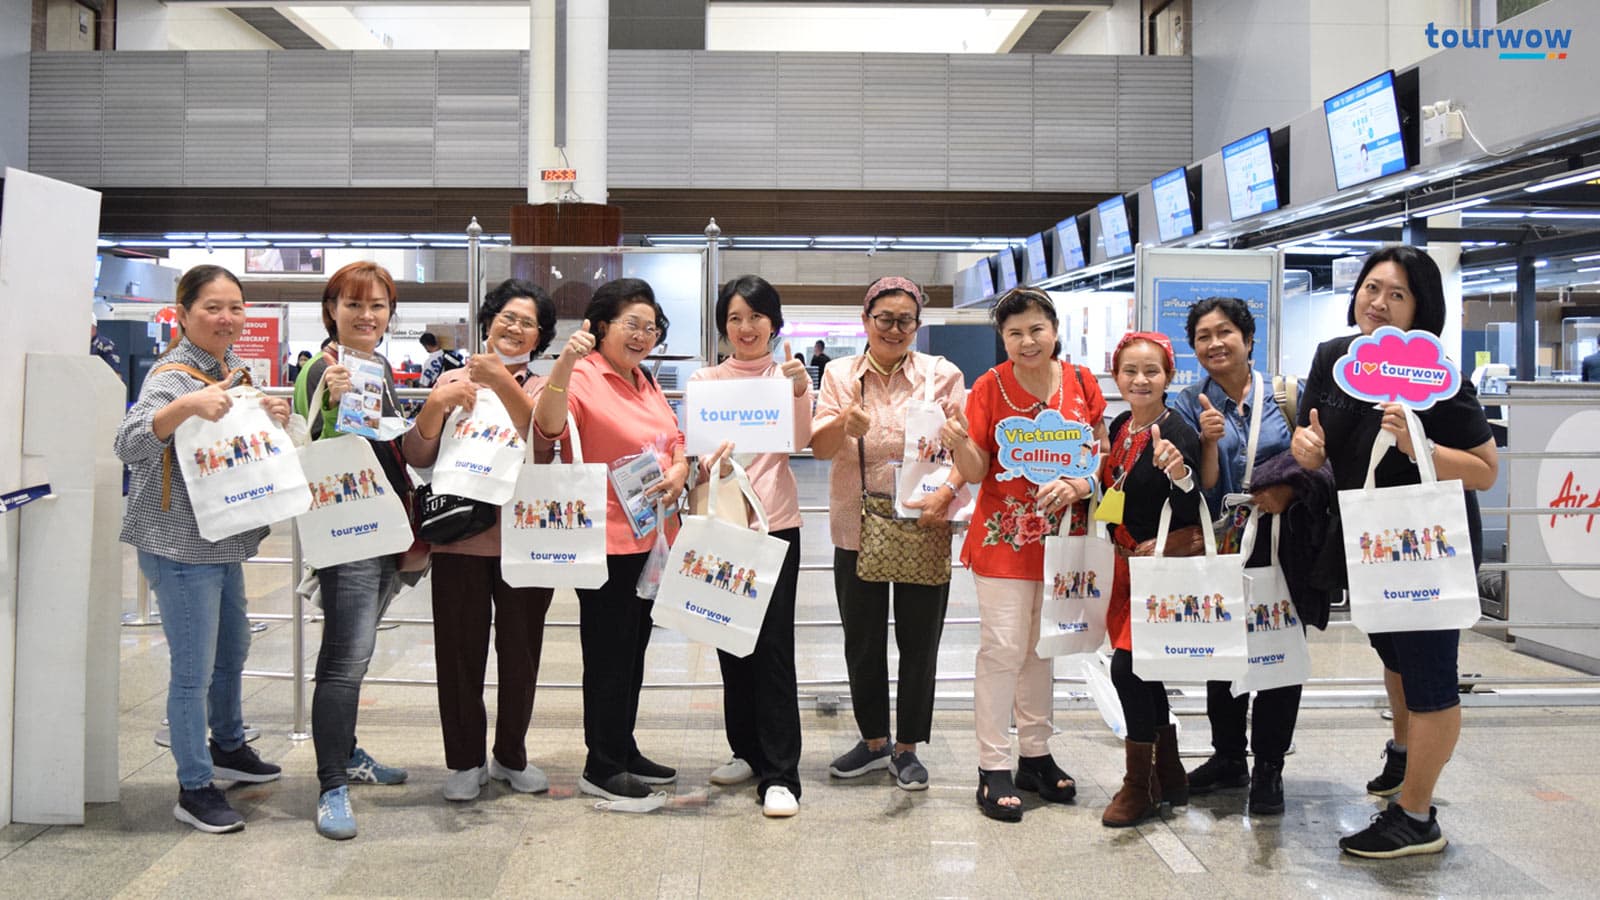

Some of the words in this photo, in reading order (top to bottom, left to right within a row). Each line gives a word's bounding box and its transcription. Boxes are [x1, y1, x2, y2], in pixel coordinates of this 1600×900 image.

[1354, 362, 1360, 373] I
[1382, 364, 1445, 379] tourwow
[700, 408, 779, 421] tourwow
[1005, 428, 1081, 444] Vietnam
[1011, 448, 1071, 466] Calling
[455, 460, 492, 472] tourwow
[225, 483, 275, 503] tourwow
[331, 522, 378, 537] tourwow
[530, 551, 576, 561] tourwow
[1384, 588, 1440, 599] tourwow
[685, 600, 731, 623] tourwow
[1058, 621, 1088, 631] tourwow
[1165, 645, 1215, 655] tourwow
[1248, 653, 1285, 664] urwow
